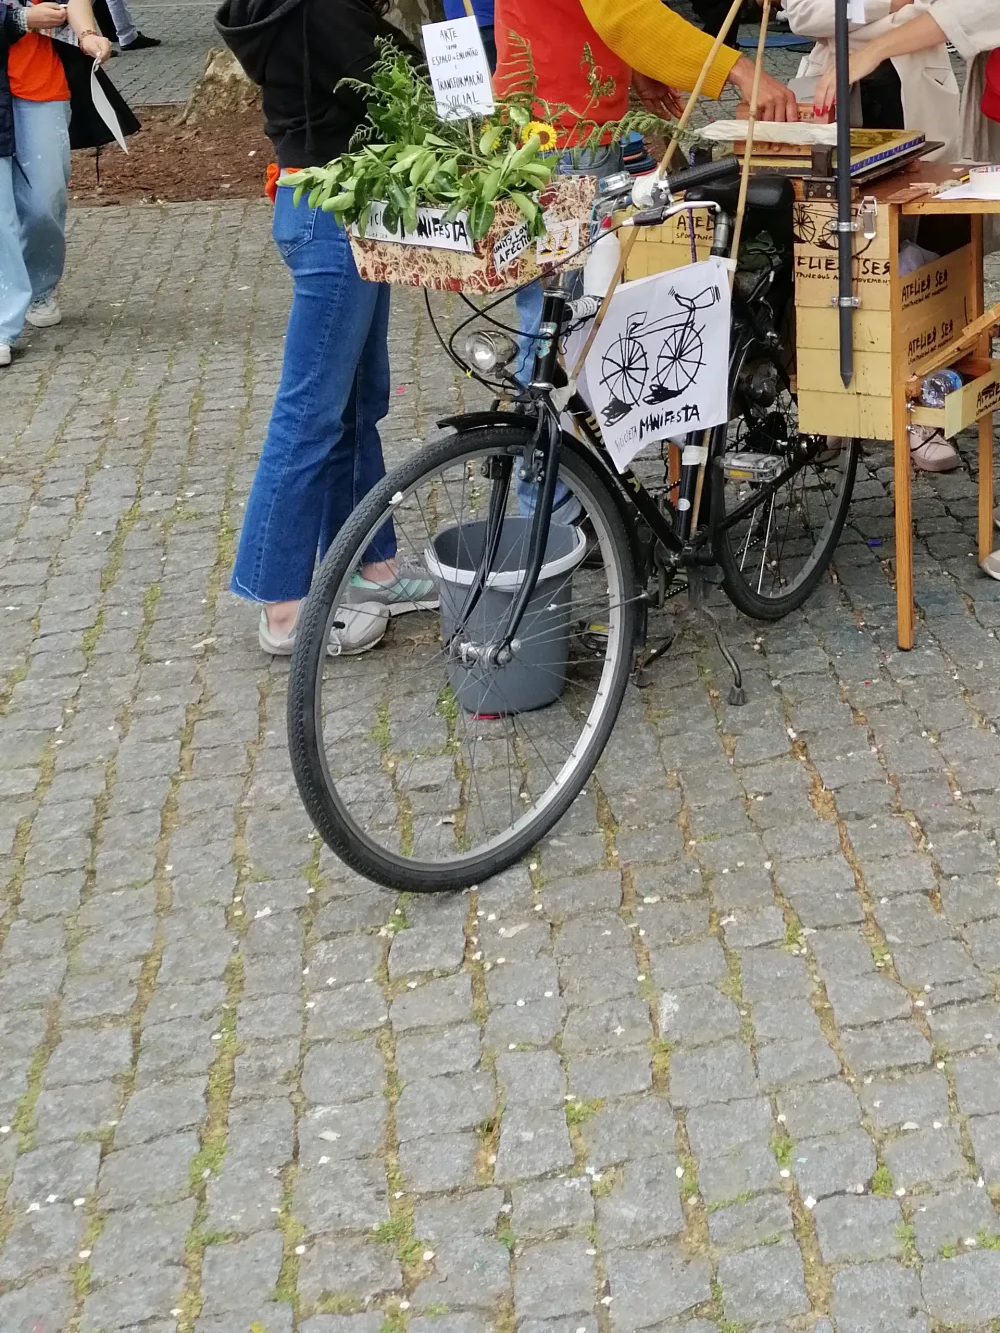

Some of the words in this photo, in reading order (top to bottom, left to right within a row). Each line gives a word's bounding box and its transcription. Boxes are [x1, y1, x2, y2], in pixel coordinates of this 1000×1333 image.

[440, 28, 458, 42] ARTE
[901, 274, 931, 303] ATELIER
[908, 326, 937, 357] ATELIER
